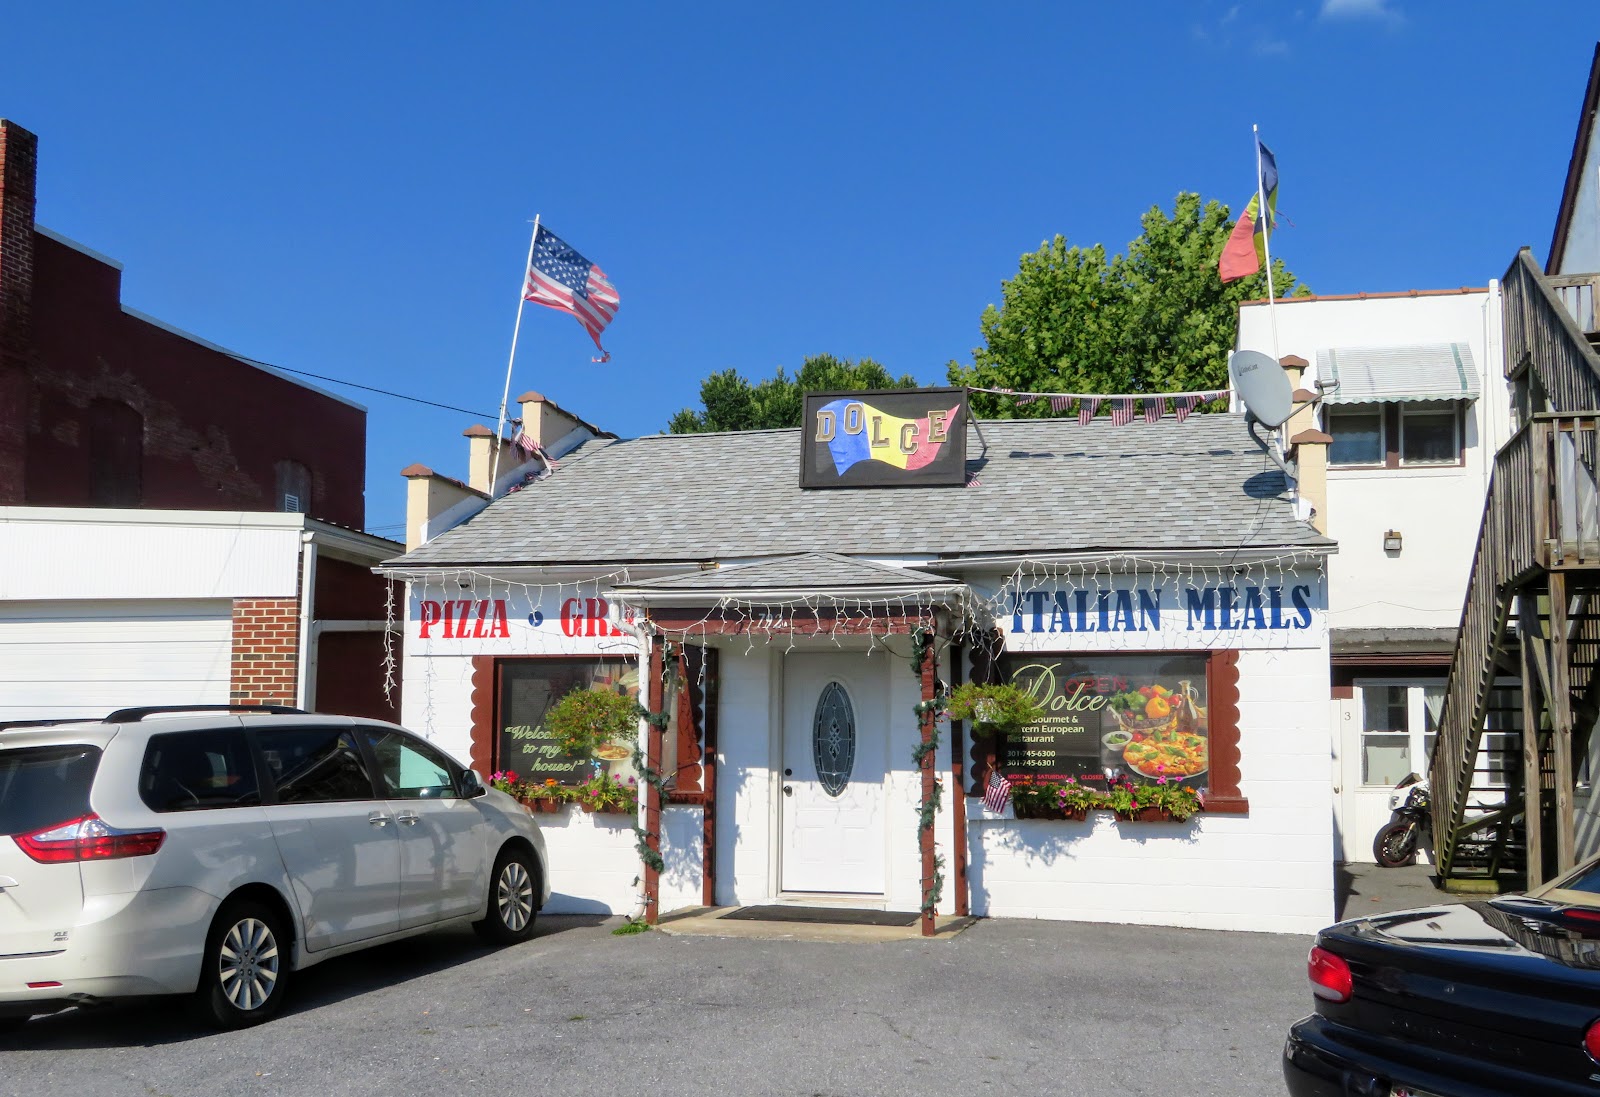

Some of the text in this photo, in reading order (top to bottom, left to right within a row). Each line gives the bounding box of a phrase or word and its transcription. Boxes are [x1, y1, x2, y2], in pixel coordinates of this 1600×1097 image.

[815, 402, 947, 455] DOLCE
[1010, 585, 1313, 634] ITALIAN MEALS
[419, 599, 510, 638] PIZZA
[1008, 662, 1108, 711] Dolce
[1065, 675, 1129, 694] OPEN
[1030, 715, 1079, 724] Gourmet &
[1344, 711, 1351, 721] 3
[1041, 724, 1085, 736] European
[1007, 734, 1055, 743] Restaurant
[523, 743, 561, 759] to my
[1007, 749, 1056, 758] 301-745-6300
[1007, 758, 1056, 767] 301-745-6301
